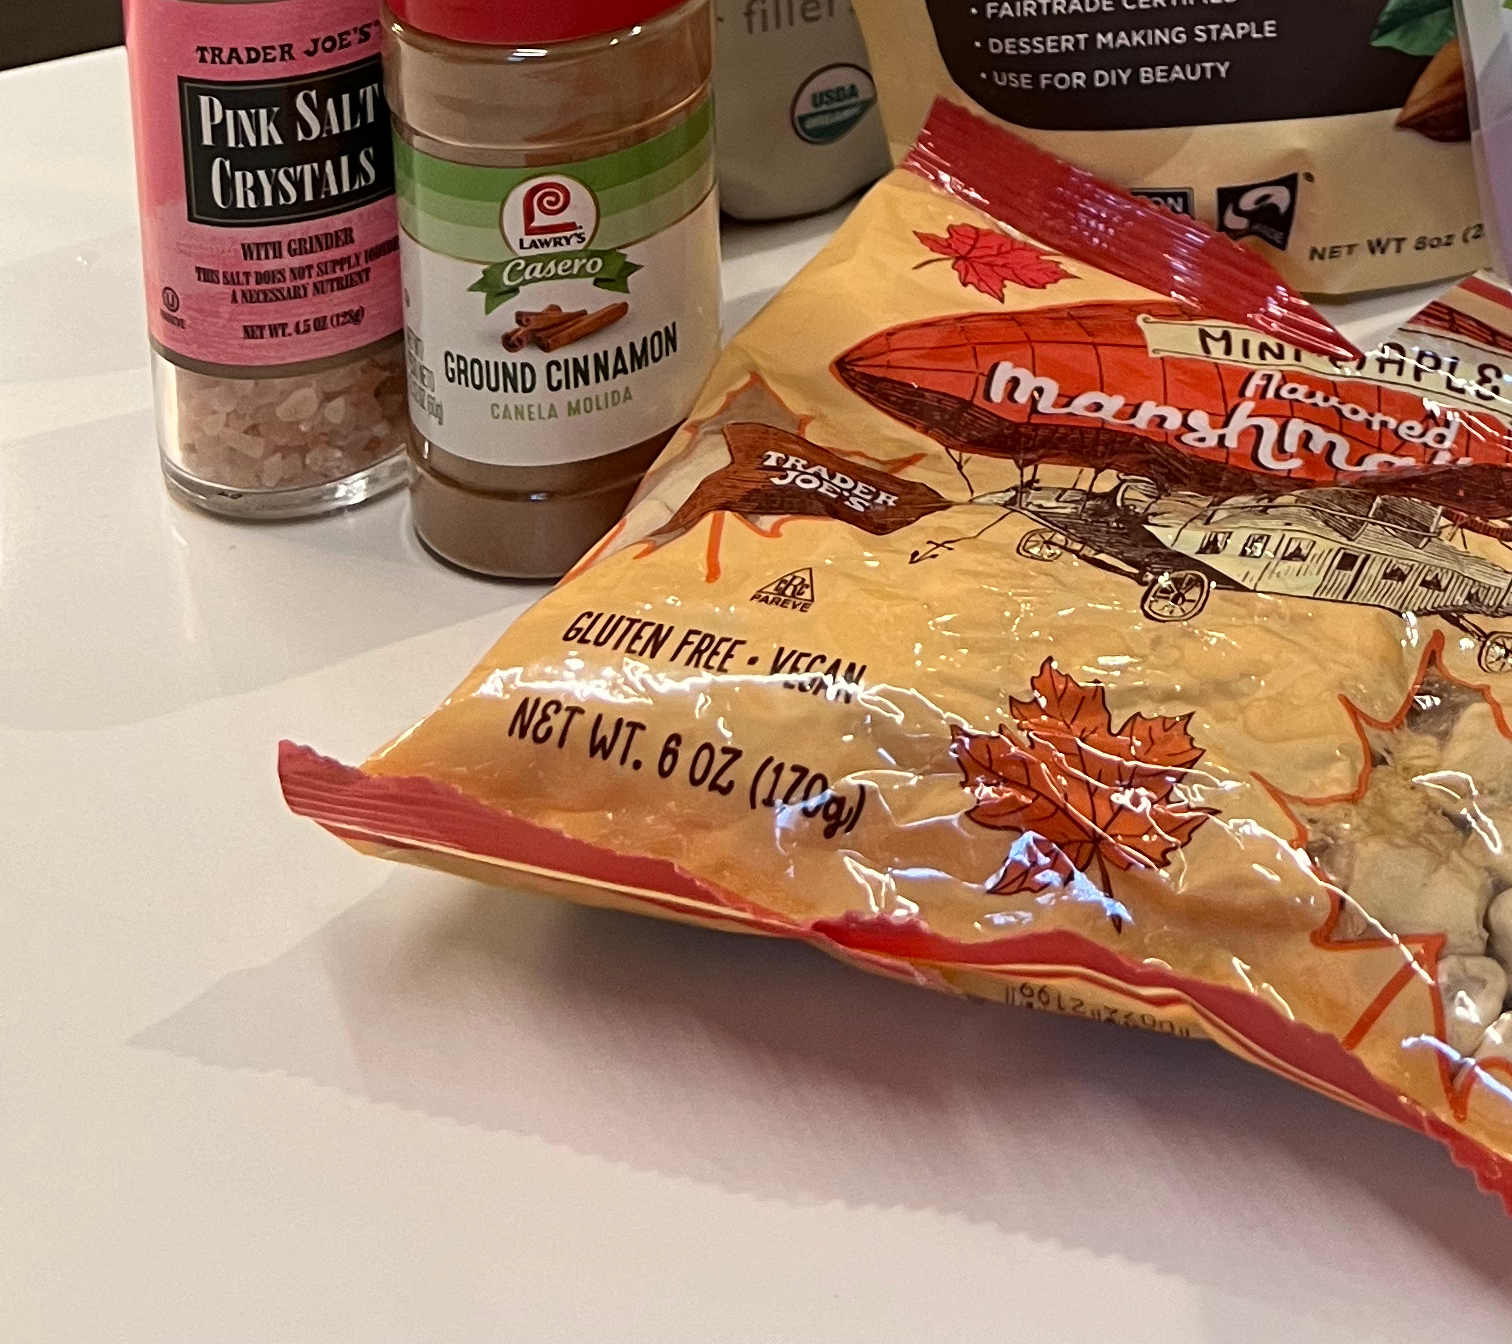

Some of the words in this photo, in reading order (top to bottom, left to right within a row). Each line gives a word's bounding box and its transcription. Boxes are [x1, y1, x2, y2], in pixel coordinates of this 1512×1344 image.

[196, 43, 295, 64] TRADER
[303, 21, 372, 57] JOE'S
[989, 33, 1088, 55] DESSERT
[1097, 26, 1187, 50] MAKING
[1194, 20, 1277, 44] STAPLE
[993, 70, 1033, 90] USE
[1040, 69, 1087, 90] FOR
[1094, 68, 1132, 87] DIY
[1140, 61, 1231, 85] BEAUTY
[198, 95, 284, 148] PINK
[295, 83, 380, 142] SALT
[211, 146, 376, 209] CRYSTALS
[241, 241, 282, 261] WITH
[287, 227, 354, 258] GRINDER
[519, 231, 586, 250] LAWRY'S
[1308, 243, 1359, 262] NET
[1366, 237, 1407, 255] WT
[195, 266, 220, 284] THIS
[223, 271, 251, 286] SALT
[255, 269, 286, 285] DOES
[289, 264, 313, 281] NOT
[316, 254, 362, 277] SUPPLY
[231, 290, 238, 304] A
[241, 286, 309, 304] NECESSARY
[312, 267, 371, 296] NUTRIENT
[502, 256, 603, 287] Casero
[243, 324, 265, 340] NET
[268, 322, 292, 338] WT.
[313, 315, 328, 331] OZ
[443, 350, 537, 394] GROUND
[547, 320, 678, 391] CINNAMON
[490, 397, 559, 422] CANELA
[567, 386, 633, 419] MOLIDA
[988, 360, 1472, 472] marshma
[1243, 370, 1458, 448] flavored
[762, 451, 899, 507] TRADER
[770, 470, 871, 512] JOE'S
[750, 593, 813, 613] PAREVE
[563, 611, 677, 661] GLUTEN
[674, 628, 747, 674] FREE
[770, 647, 867, 704] VEGAN
[508, 696, 585, 750] NET
[589, 713, 646, 771] WT.
[658, 733, 683, 778] 6
[688, 742, 743, 797] OZ
